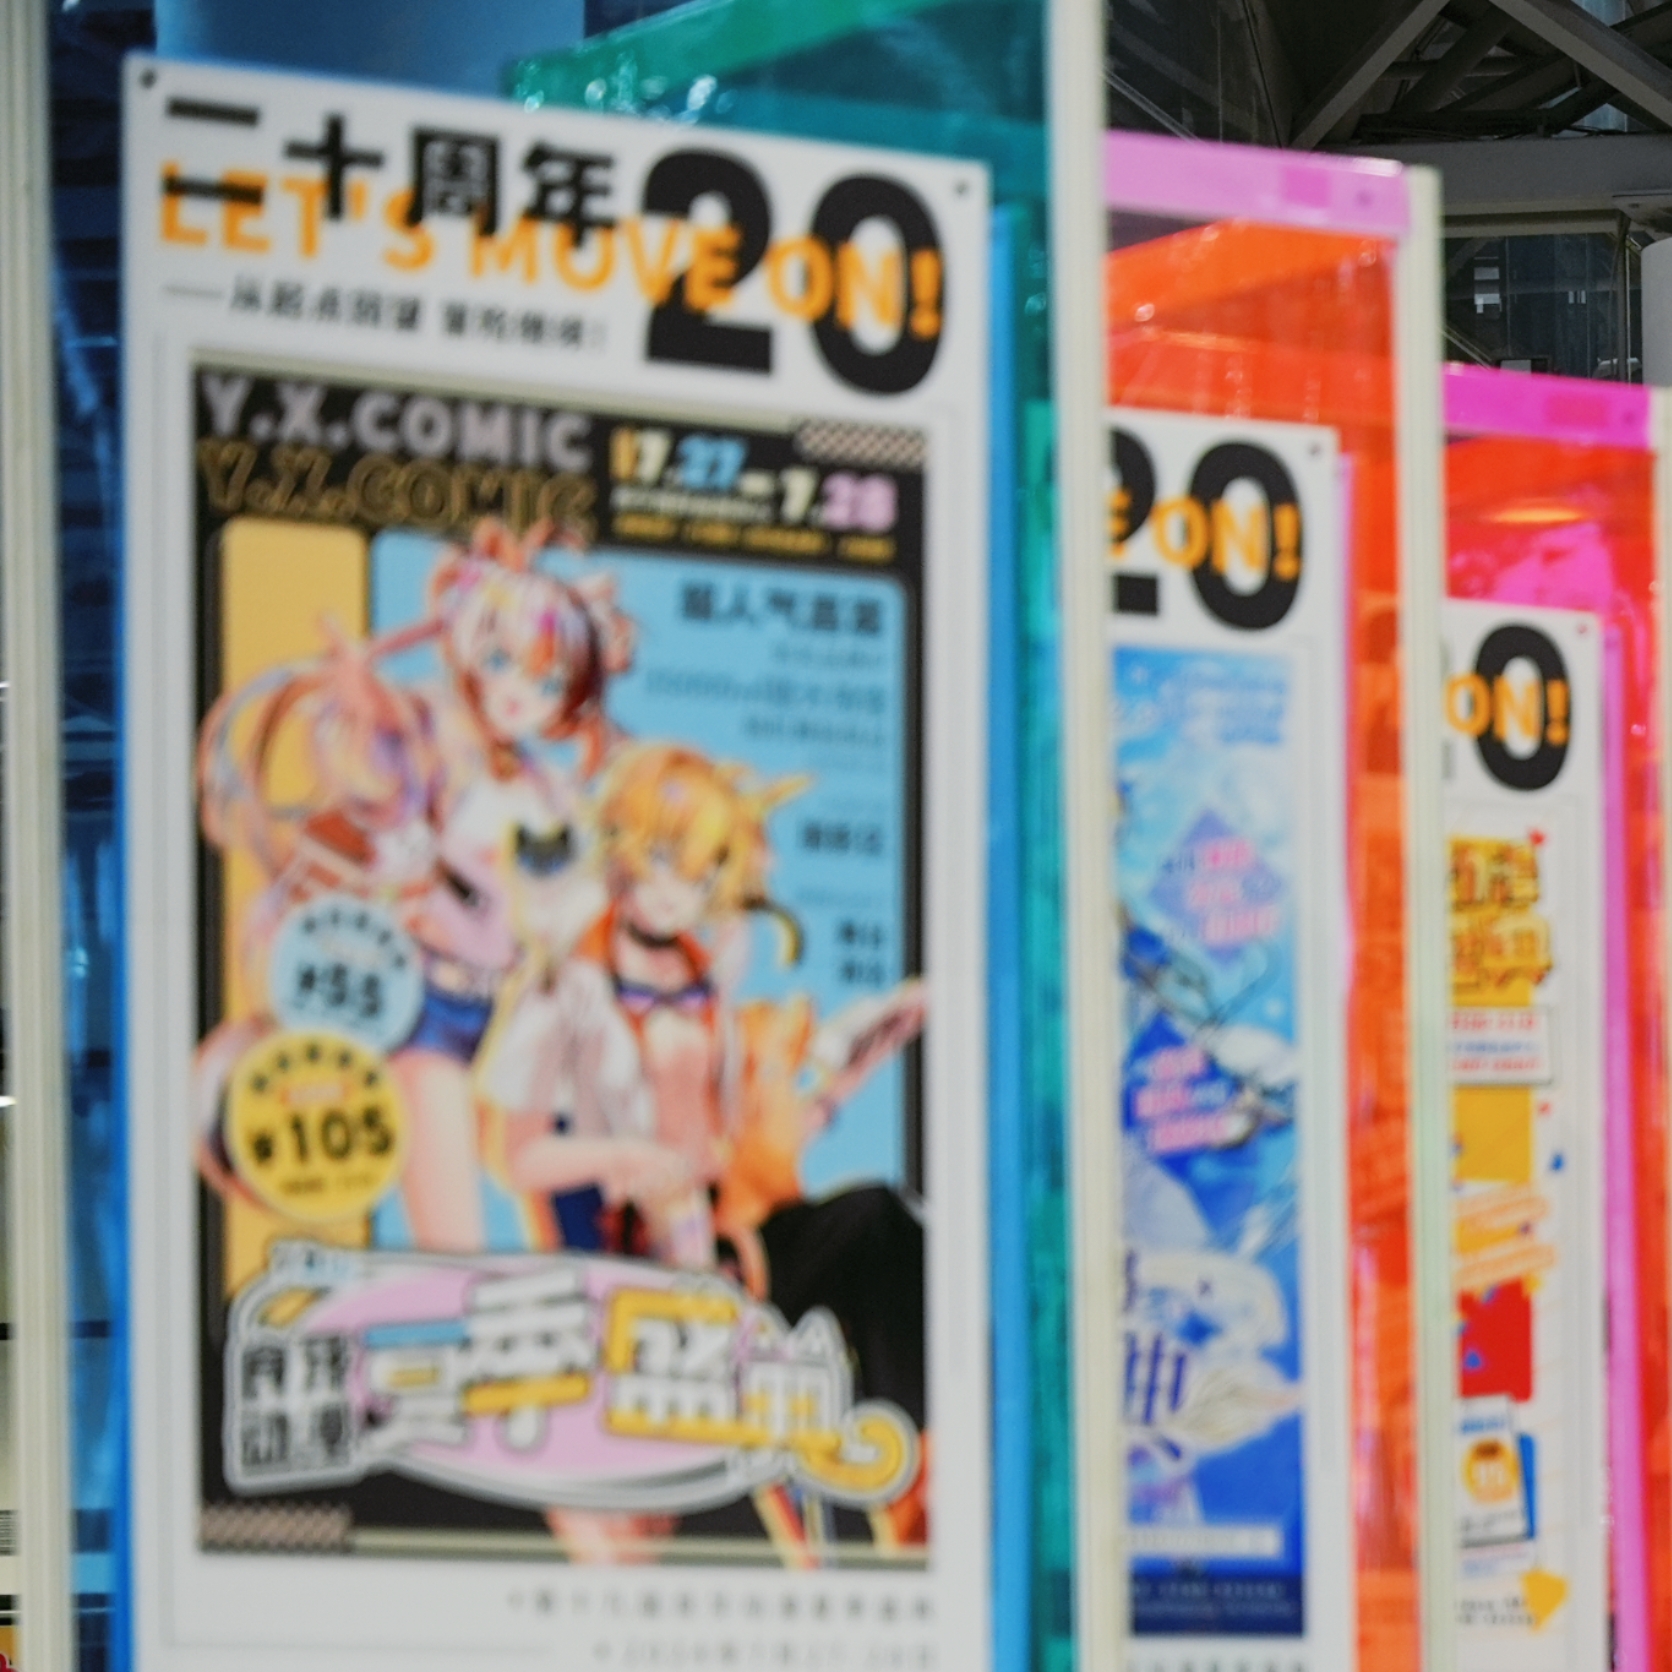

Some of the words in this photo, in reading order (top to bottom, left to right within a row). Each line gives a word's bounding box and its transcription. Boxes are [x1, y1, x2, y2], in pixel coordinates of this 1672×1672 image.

[642, 147, 945, 397] 20
[767, 234, 943, 339] ON!
[1151, 494, 1302, 583] ON!
[1443, 671, 1571, 748] ON!
